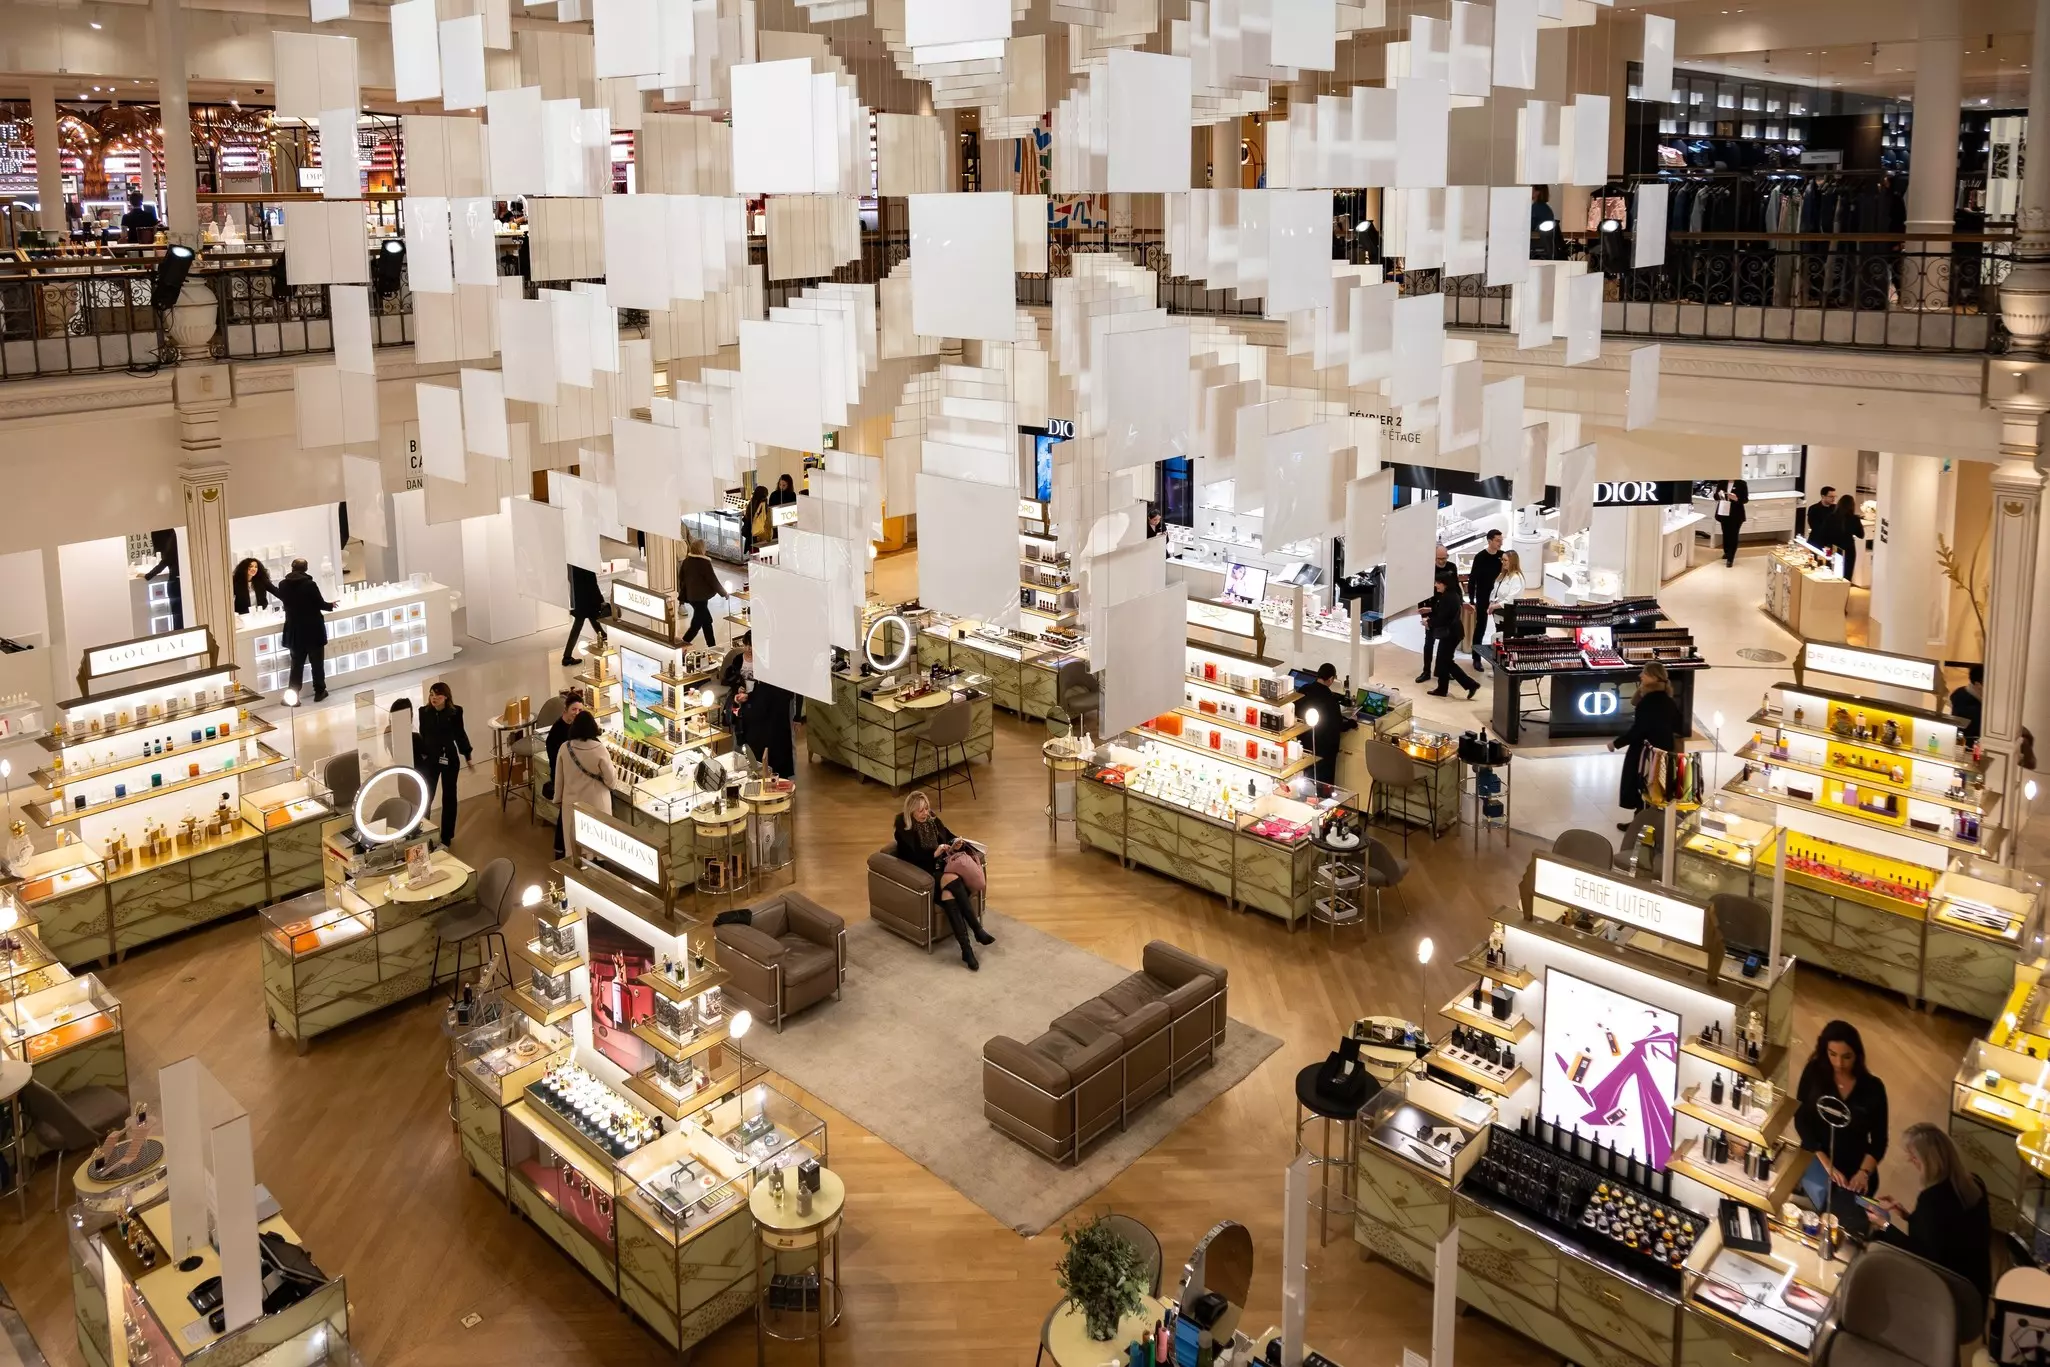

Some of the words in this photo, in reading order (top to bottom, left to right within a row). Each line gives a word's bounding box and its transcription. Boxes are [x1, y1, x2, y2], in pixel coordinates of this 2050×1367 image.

[1349, 410, 1393, 426] FÉER
[1388, 428, 1421, 444] ÉTAGE
[1592, 480, 1659, 503] DIOR
[1807, 650, 1847, 665] DRIES
[1883, 664, 1932, 681] NOTEN
[1573, 877, 1611, 907] SERGE
[1615, 889, 1662, 923] LUTENS
